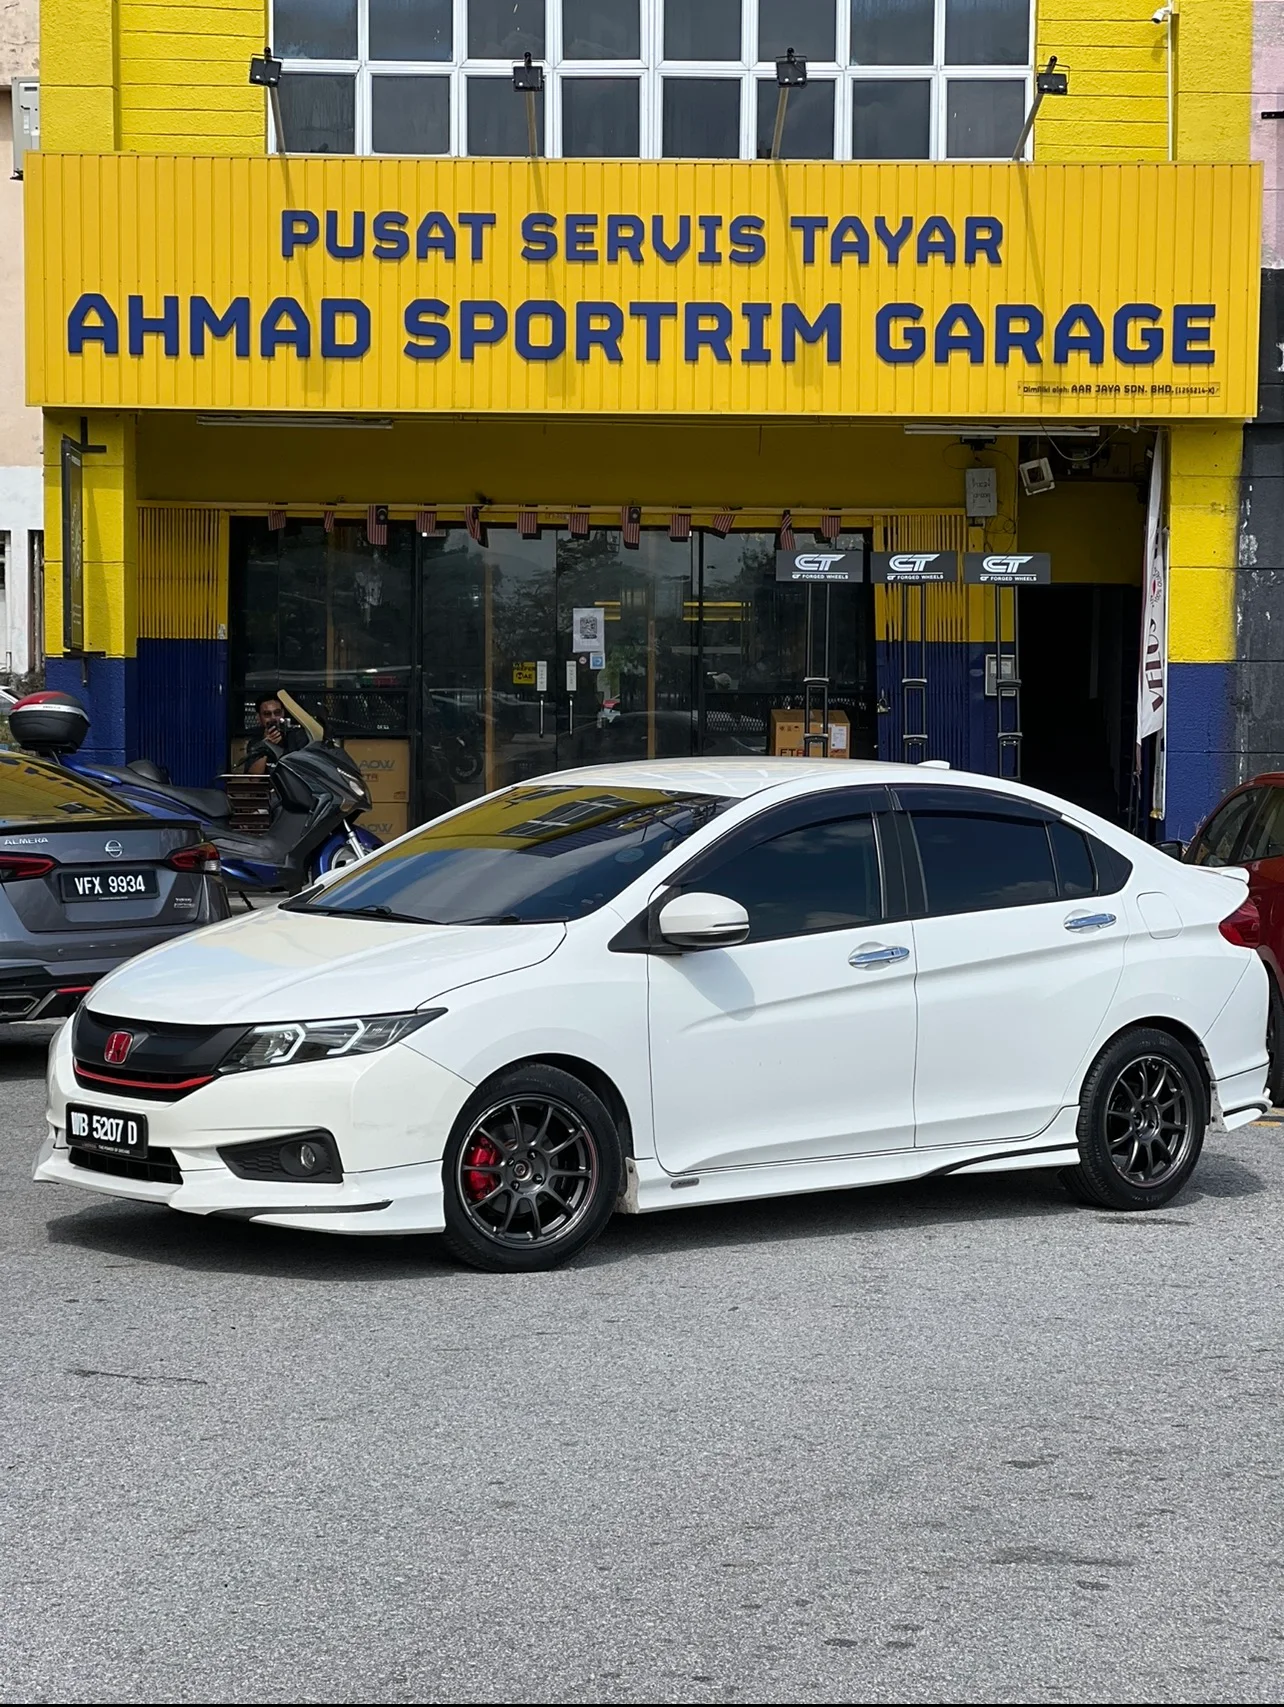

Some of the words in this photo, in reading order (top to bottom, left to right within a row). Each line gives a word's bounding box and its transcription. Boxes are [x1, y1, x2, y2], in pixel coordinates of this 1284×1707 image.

[283, 212, 496, 260] PUSAT
[522, 214, 765, 262] SERVIS
[790, 218, 1003, 264] TAYAR
[68, 294, 371, 359] AHMAD
[404, 300, 841, 363] SPORTRIM
[876, 304, 1216, 365] GARAGE
[1071, 384, 1092, 393] AAR
[1095, 384, 1121, 393] JAYA
[1124, 384, 1148, 394] SDN.
[1151, 384, 1174, 394] BHD.
[4, 837, 49, 846] ALMERA
[74, 877, 103, 895] VFX
[108, 874, 146, 893] 9934
[70, 1111, 89, 1137] WB
[92, 1114, 124, 1143] 5207
[127, 1120, 138, 1145] D
